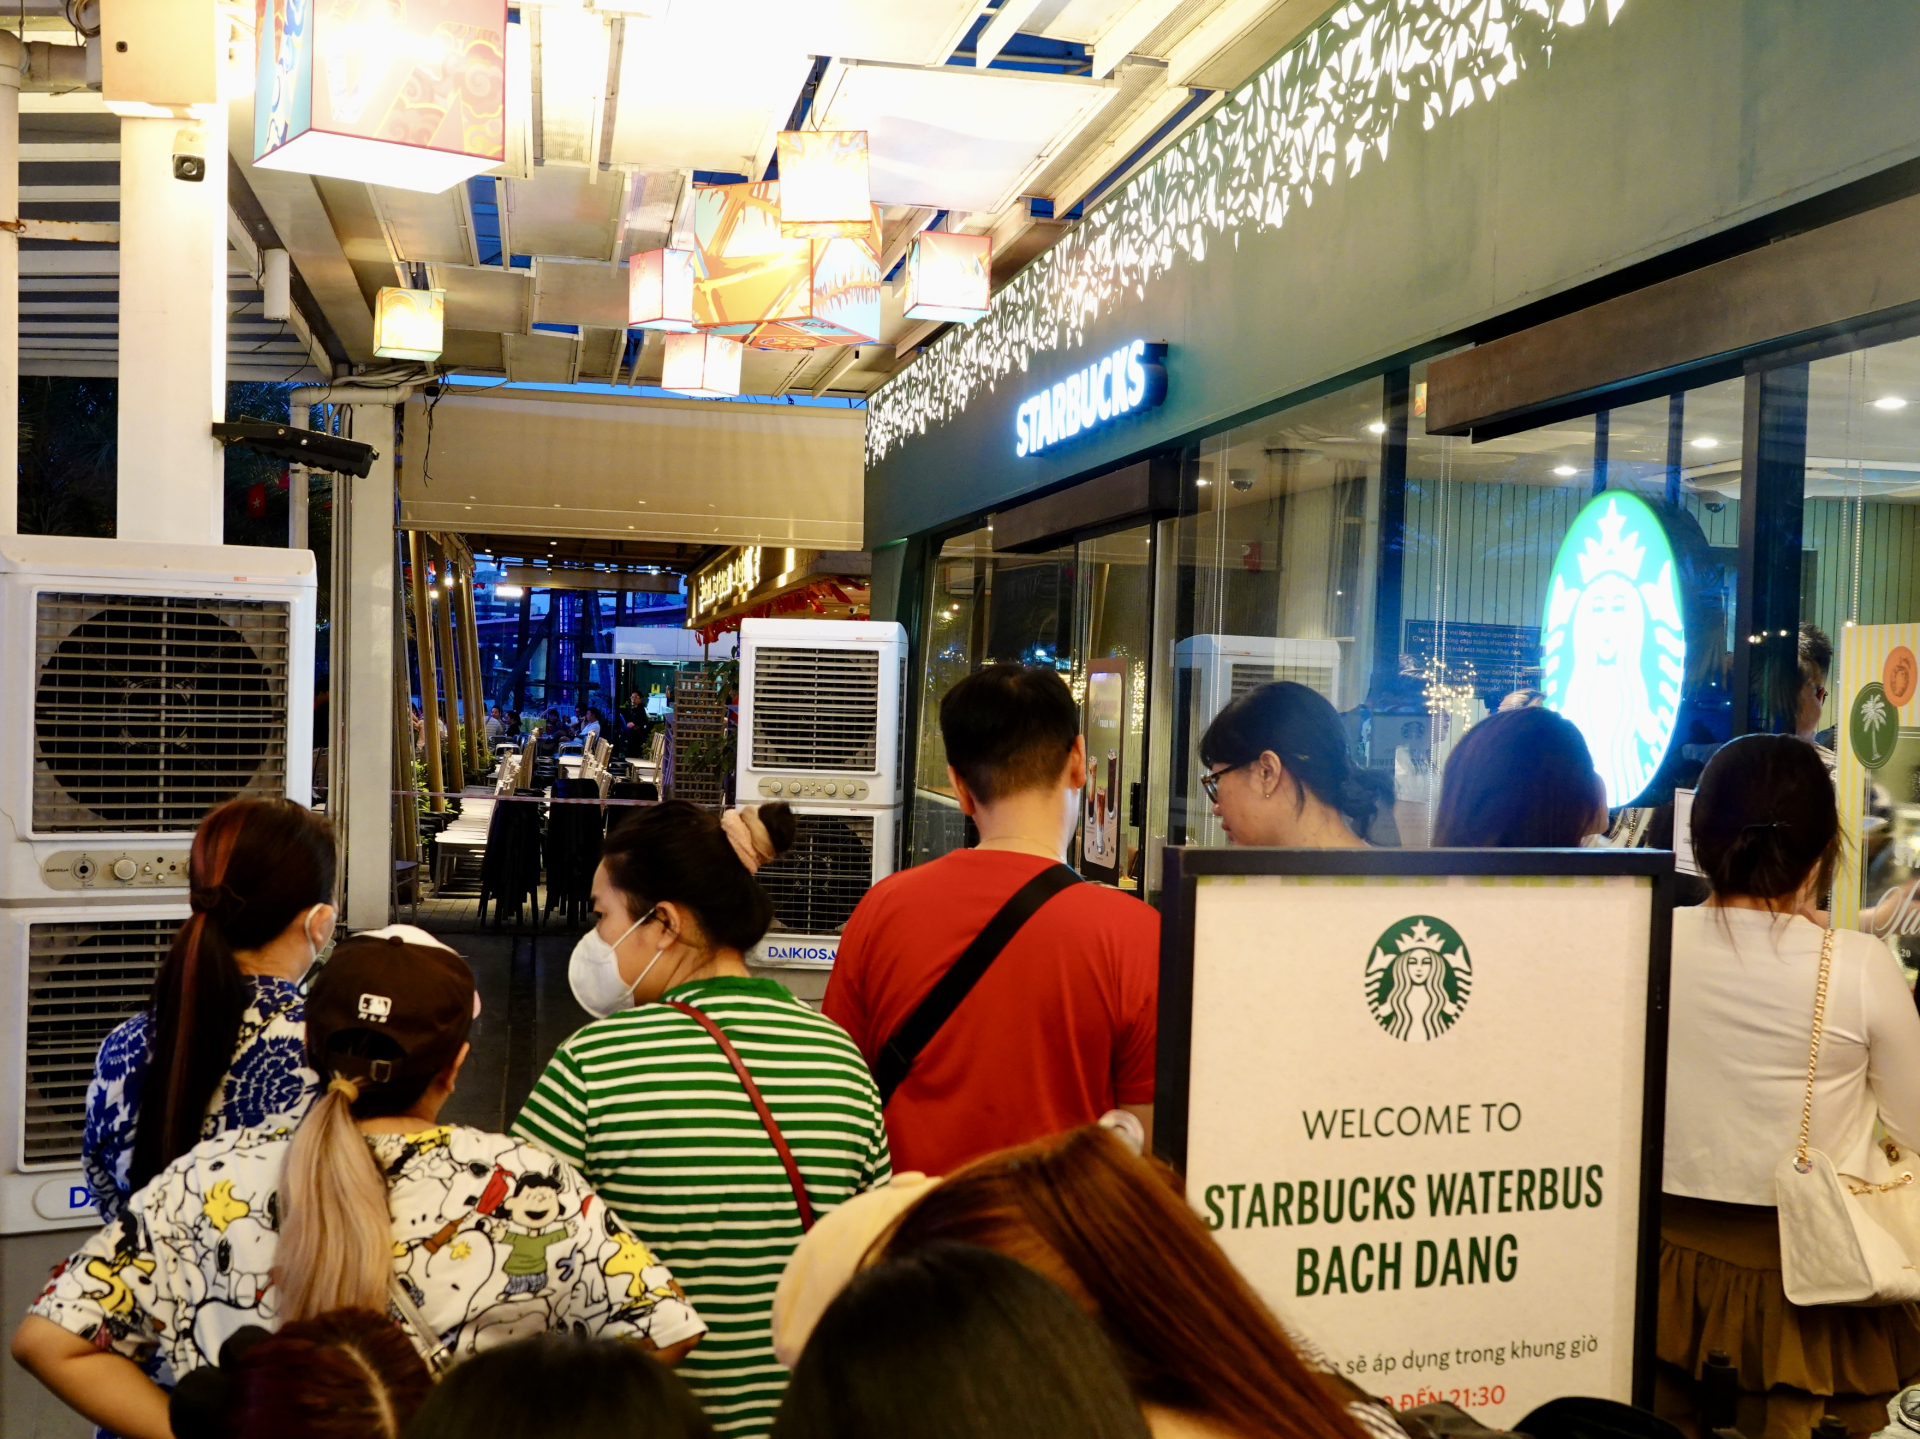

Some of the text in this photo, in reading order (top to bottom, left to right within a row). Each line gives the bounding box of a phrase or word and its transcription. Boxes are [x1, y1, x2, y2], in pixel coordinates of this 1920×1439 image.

[1016, 339, 1145, 457] STARBUCKS
[1301, 1102, 1522, 1140] WELCOME TO
[1203, 1164, 1604, 1231] STARBUCKS WATERBUS
[1296, 1233, 1518, 1297] BACH DANG
[1345, 1354, 1367, 1375] sẽ
[1372, 1352, 1397, 1375] áp
[1402, 1347, 1450, 1373] dụng
[1456, 1345, 1506, 1365] trong
[1510, 1340, 1566, 1361] khung
[1570, 1334, 1598, 1357] giờ
[1449, 1385, 1506, 1408] 21:30
